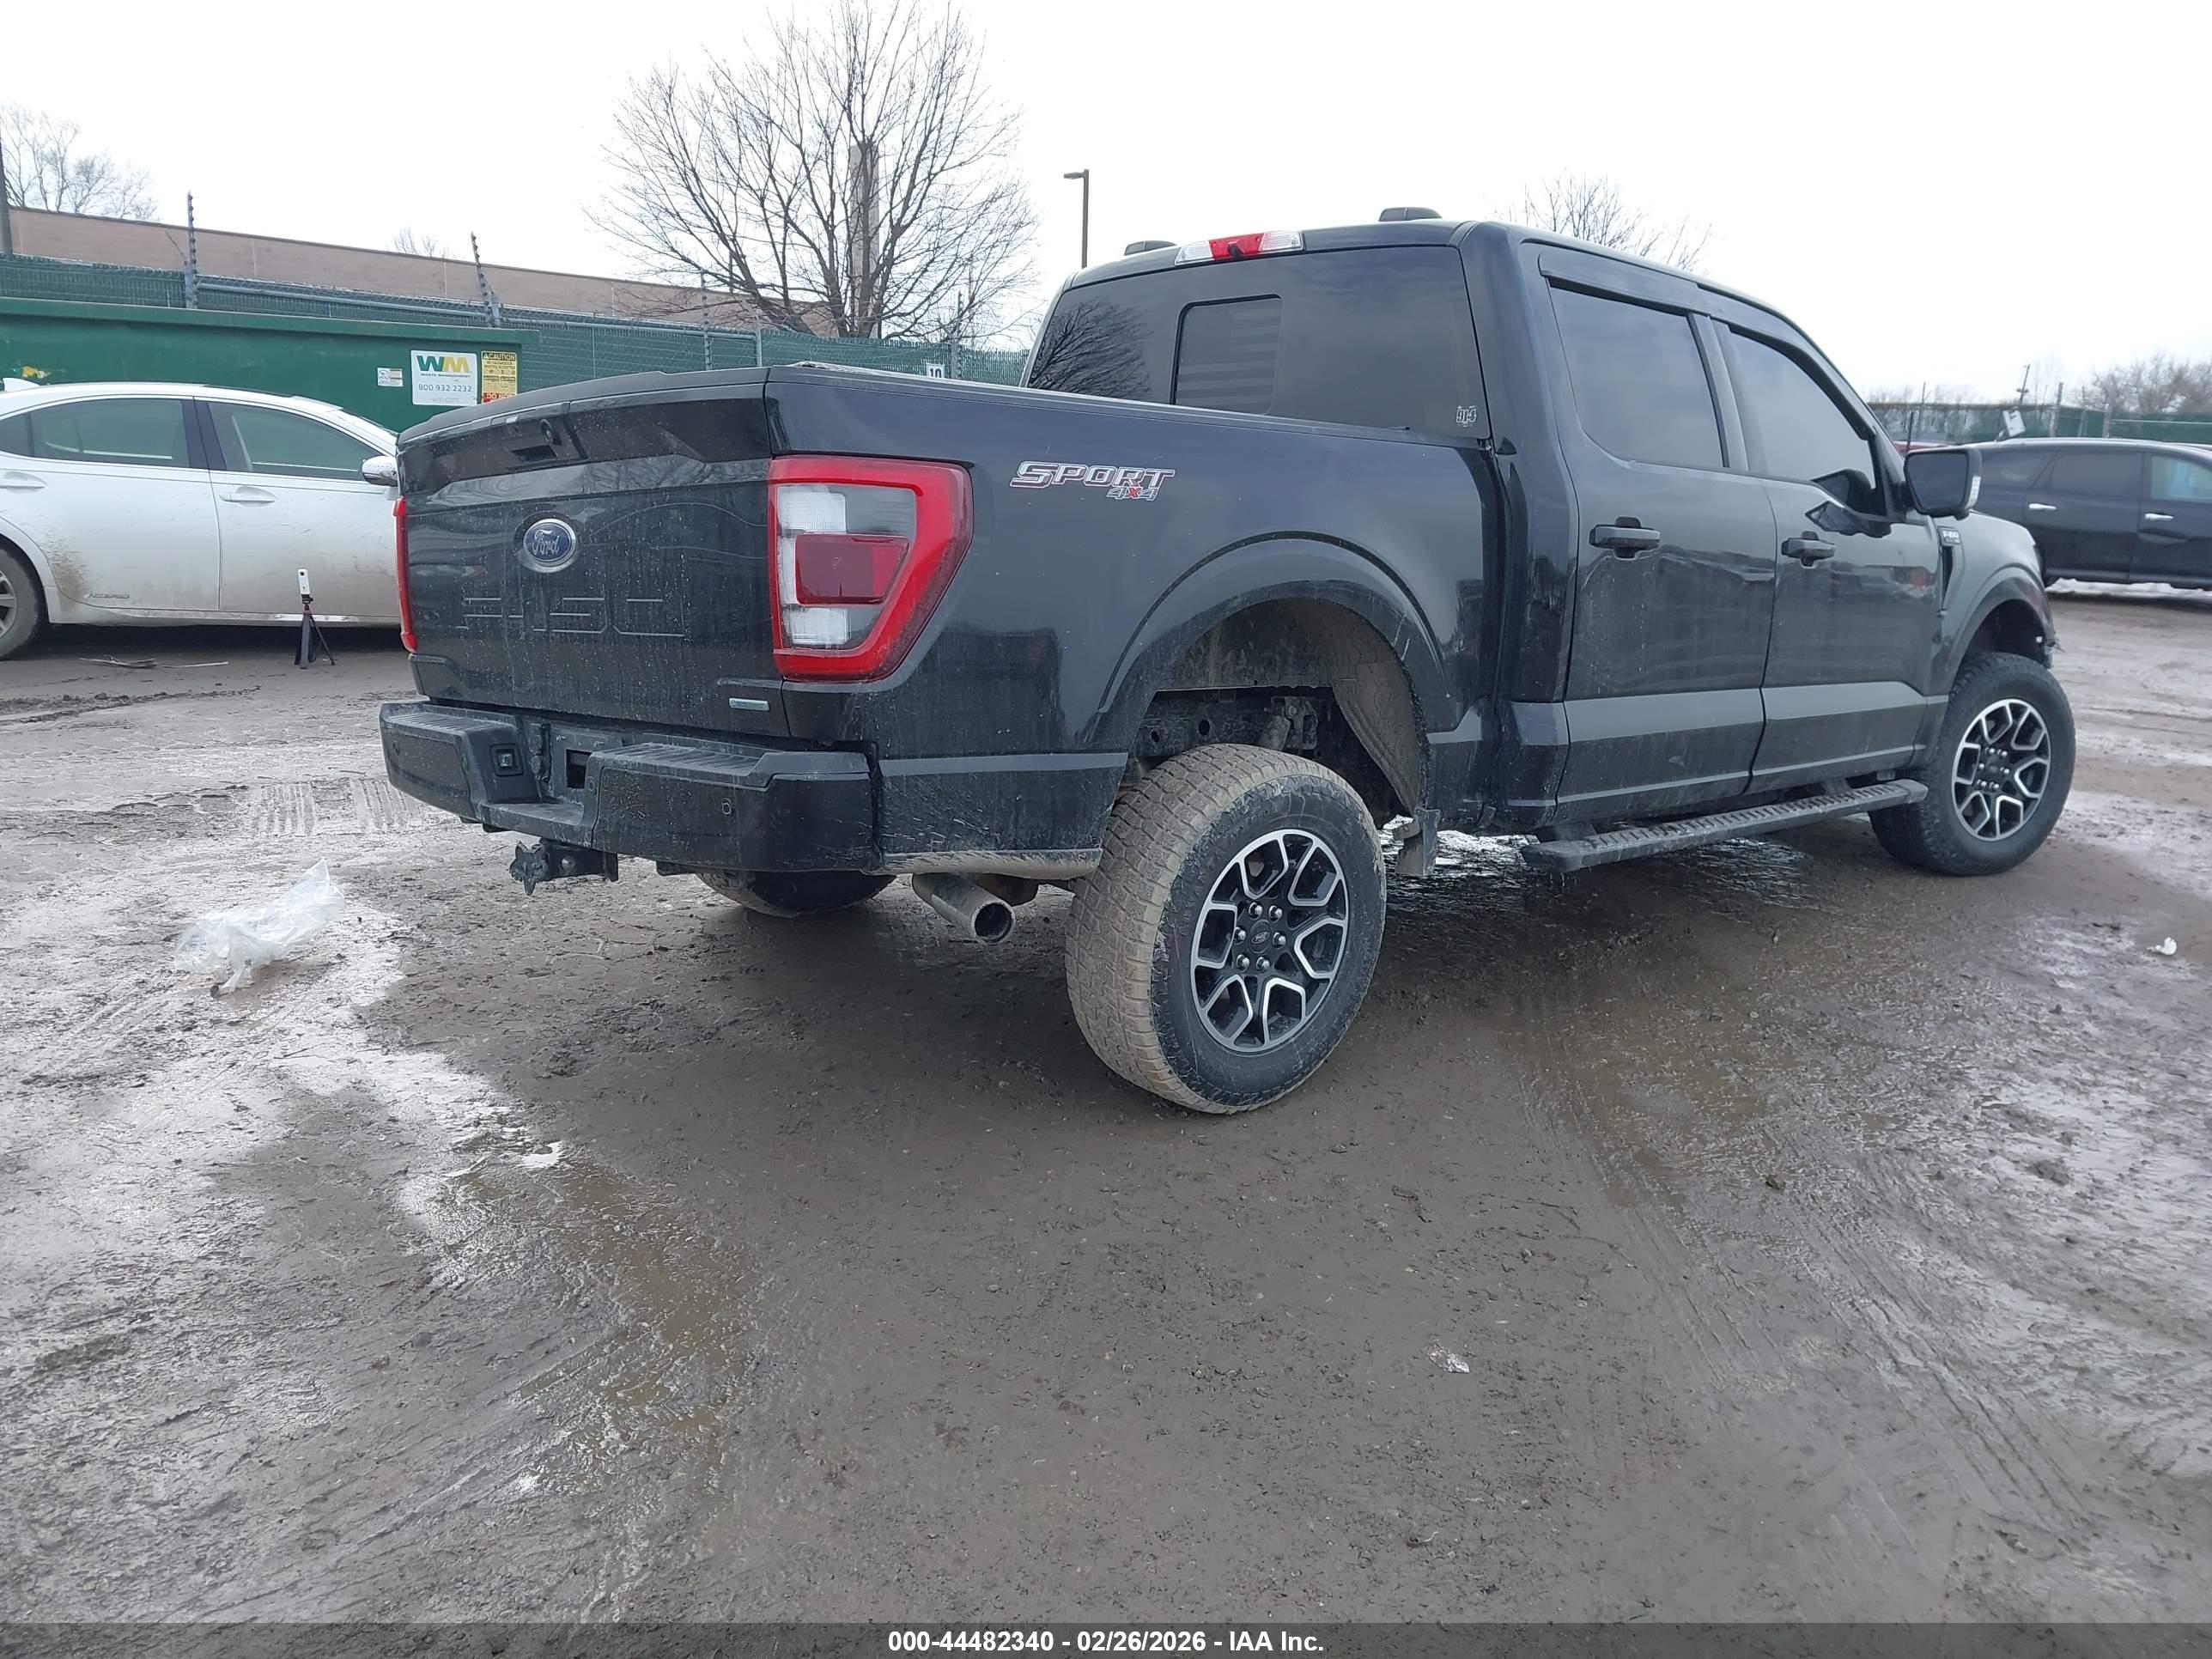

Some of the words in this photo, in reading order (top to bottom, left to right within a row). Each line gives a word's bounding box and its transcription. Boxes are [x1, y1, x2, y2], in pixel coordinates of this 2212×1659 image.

[416, 355, 470, 373] WM
[489, 352, 515, 361] CAUTION
[418, 383, 434, 392] 800
[1010, 461, 1176, 489] SPORT
[532, 529, 560, 556] Ford
